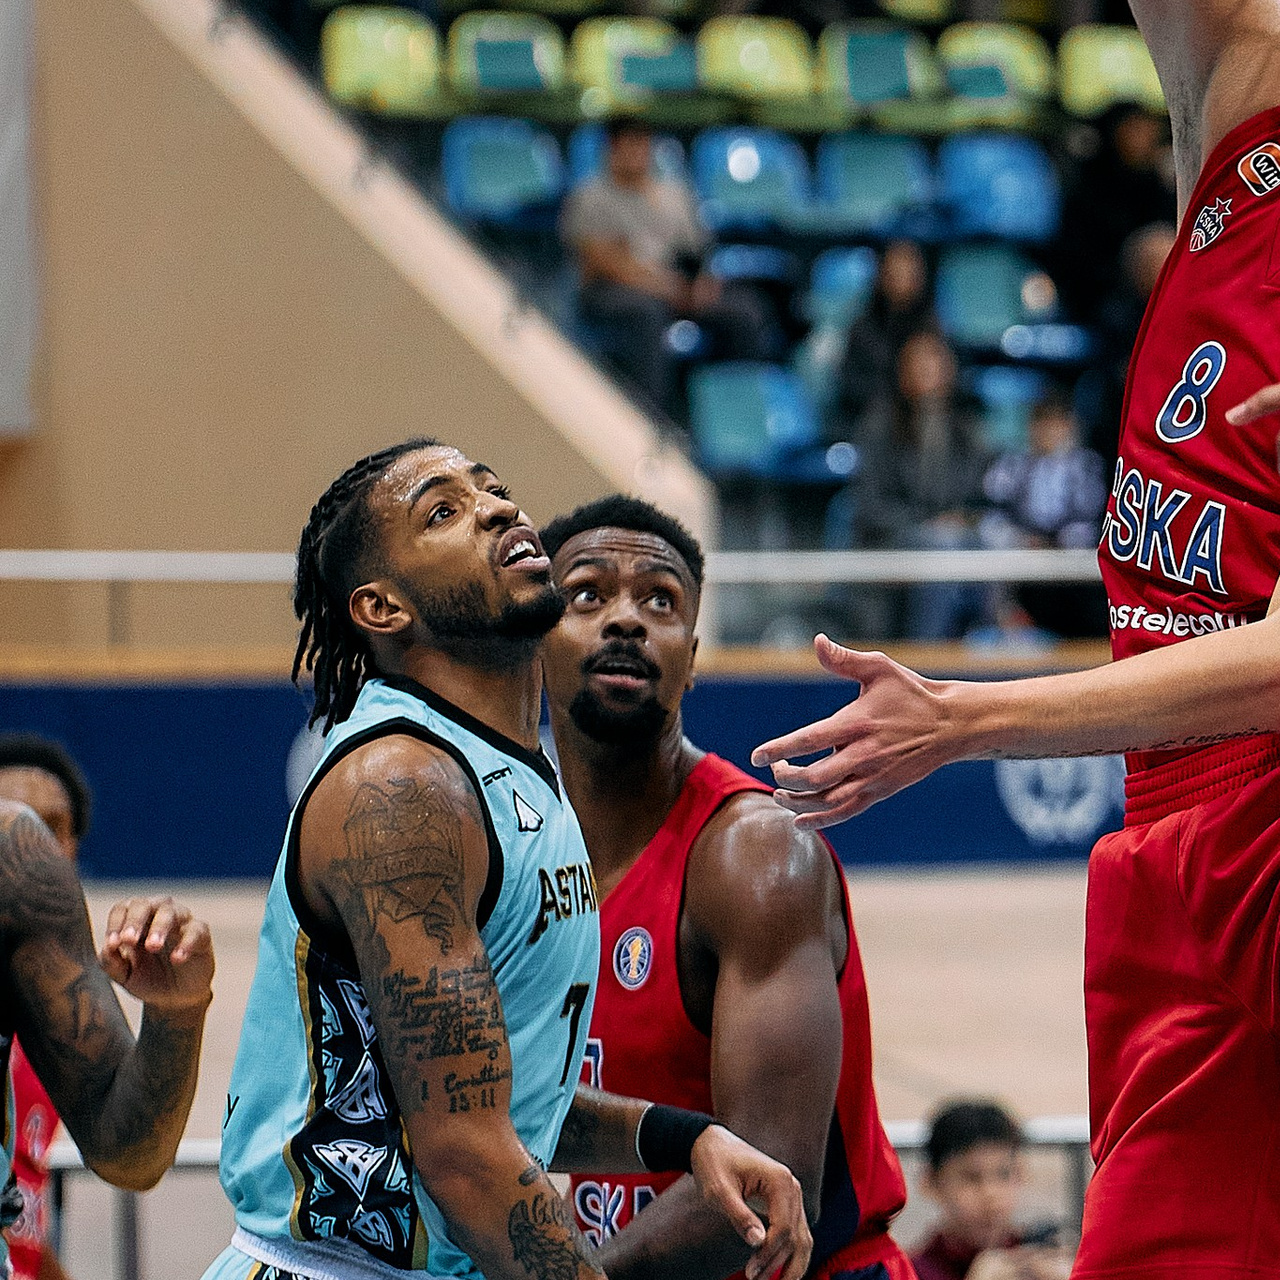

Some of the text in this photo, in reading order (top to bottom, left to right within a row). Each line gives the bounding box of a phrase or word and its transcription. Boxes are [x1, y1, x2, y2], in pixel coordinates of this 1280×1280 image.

[1199, 212, 1219, 238] CSKA
[1155, 340, 1227, 444] 8
[1098, 456, 1229, 595] SKA
[560, 982, 590, 1087] 7
